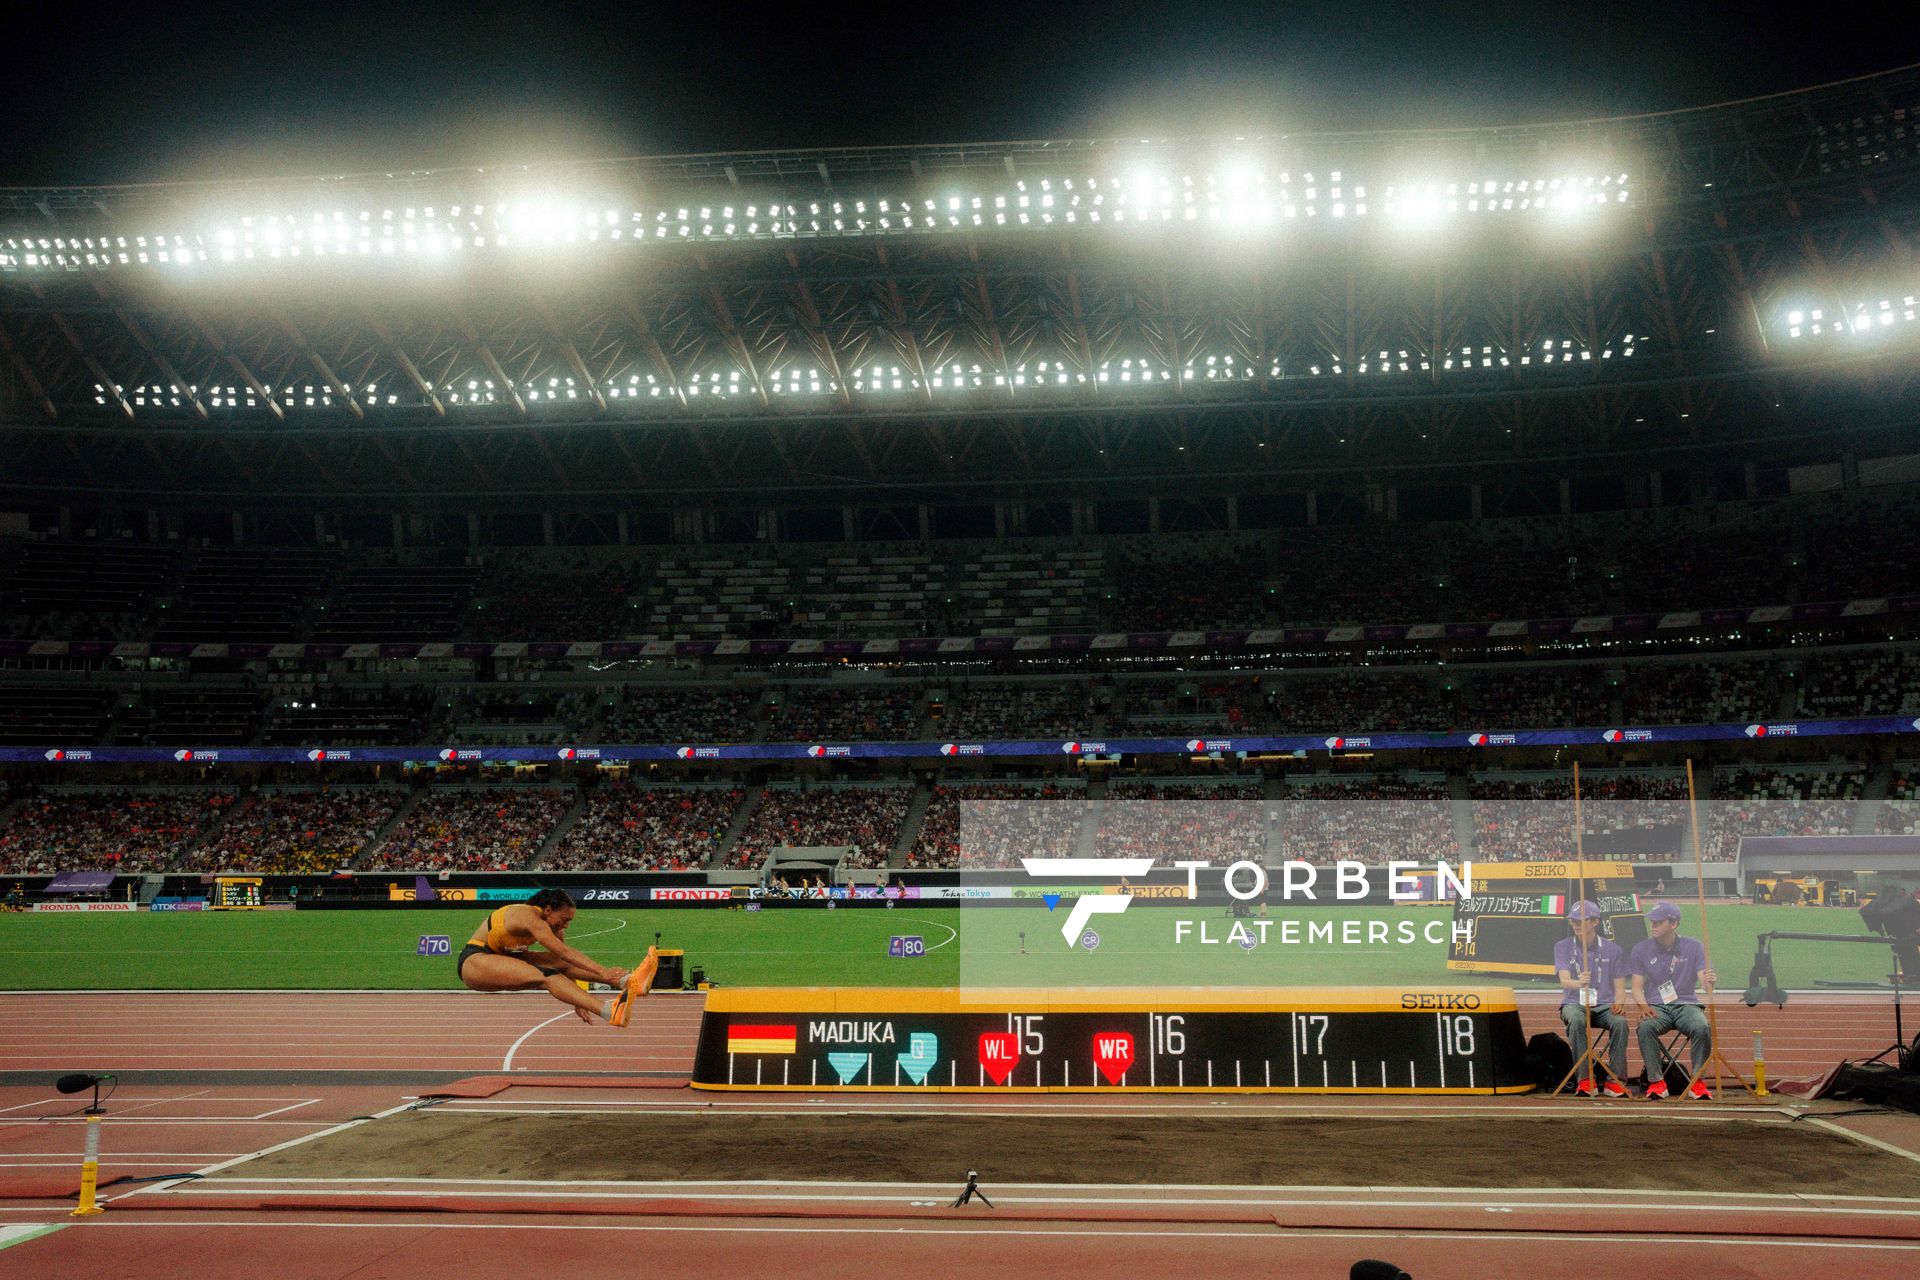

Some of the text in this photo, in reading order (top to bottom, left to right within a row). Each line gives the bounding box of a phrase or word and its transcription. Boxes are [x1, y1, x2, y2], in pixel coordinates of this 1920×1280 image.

[1525, 864, 1567, 876] SEIKO
[403, 890, 464, 900] SKO
[598, 891, 630, 900] asics
[655, 890, 731, 900] HONDA
[966, 889, 991, 899] Tokyo
[1117, 886, 1184, 898] SEIKO
[429, 940, 449, 953] 70
[905, 940, 923, 954] 80
[1083, 936, 1097, 945] CR
[1401, 993, 1481, 1010] SEIKO
[808, 1020, 896, 1044] MADUKA
[1013, 1015, 1044, 1055] 15
[1154, 1014, 1186, 1055] 16
[1298, 1015, 1329, 1055] 17
[1442, 1015, 1475, 1056] 18
[984, 1039, 1013, 1060] WL
[1099, 1039, 1129, 1059] WR
